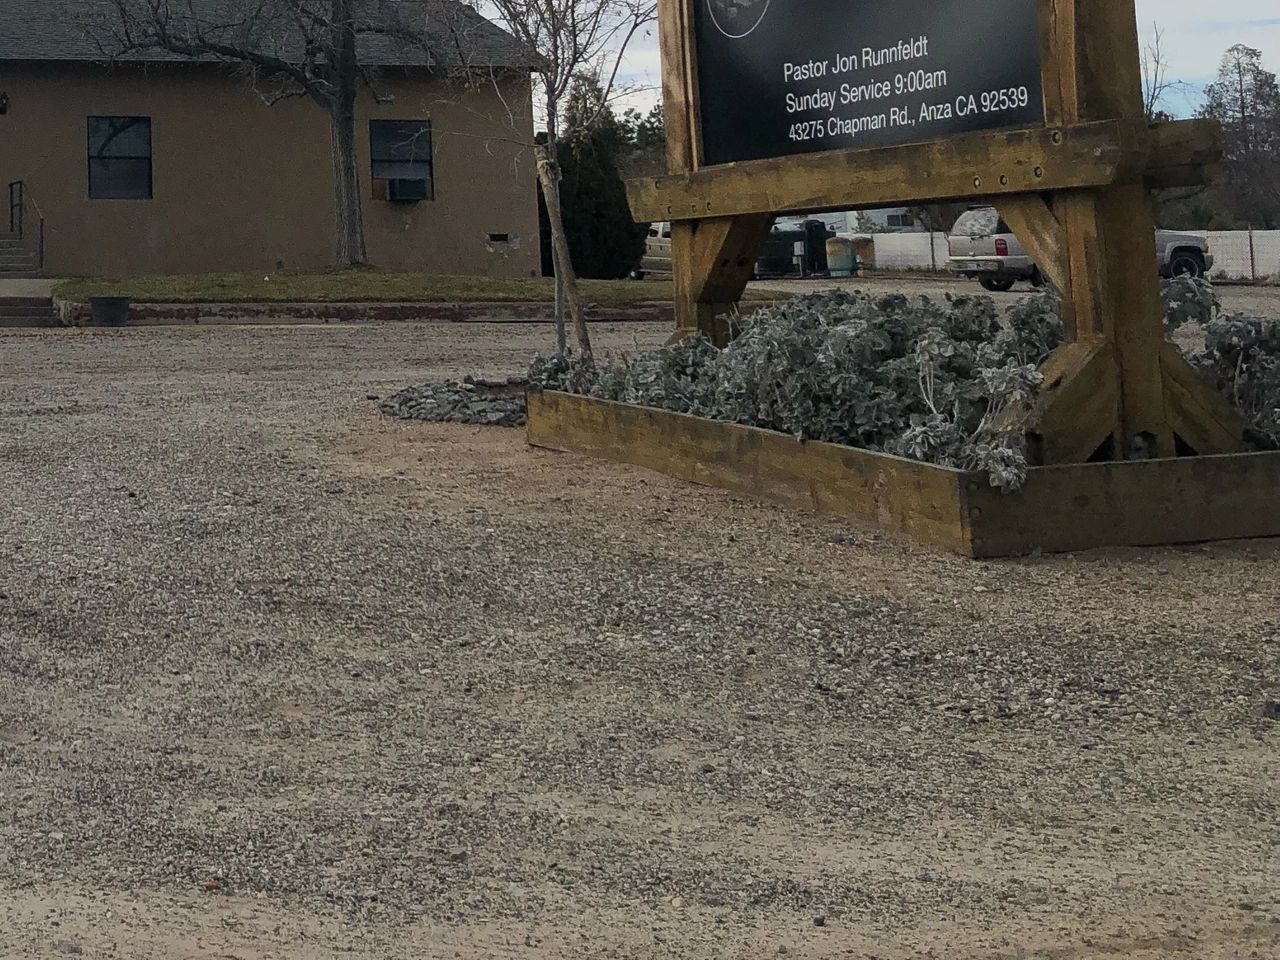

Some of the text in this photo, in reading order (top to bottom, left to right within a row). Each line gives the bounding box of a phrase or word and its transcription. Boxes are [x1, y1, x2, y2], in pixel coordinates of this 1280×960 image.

[783, 36, 928, 82] Pastor Jon Runnfeldt
[785, 69, 947, 113] Sunday Service 9:00am
[789, 120, 825, 141] 43275
[827, 112, 886, 137] Chapman
[919, 101, 952, 122] Anza
[955, 94, 977, 116] CA
[981, 86, 1028, 112] 92539
